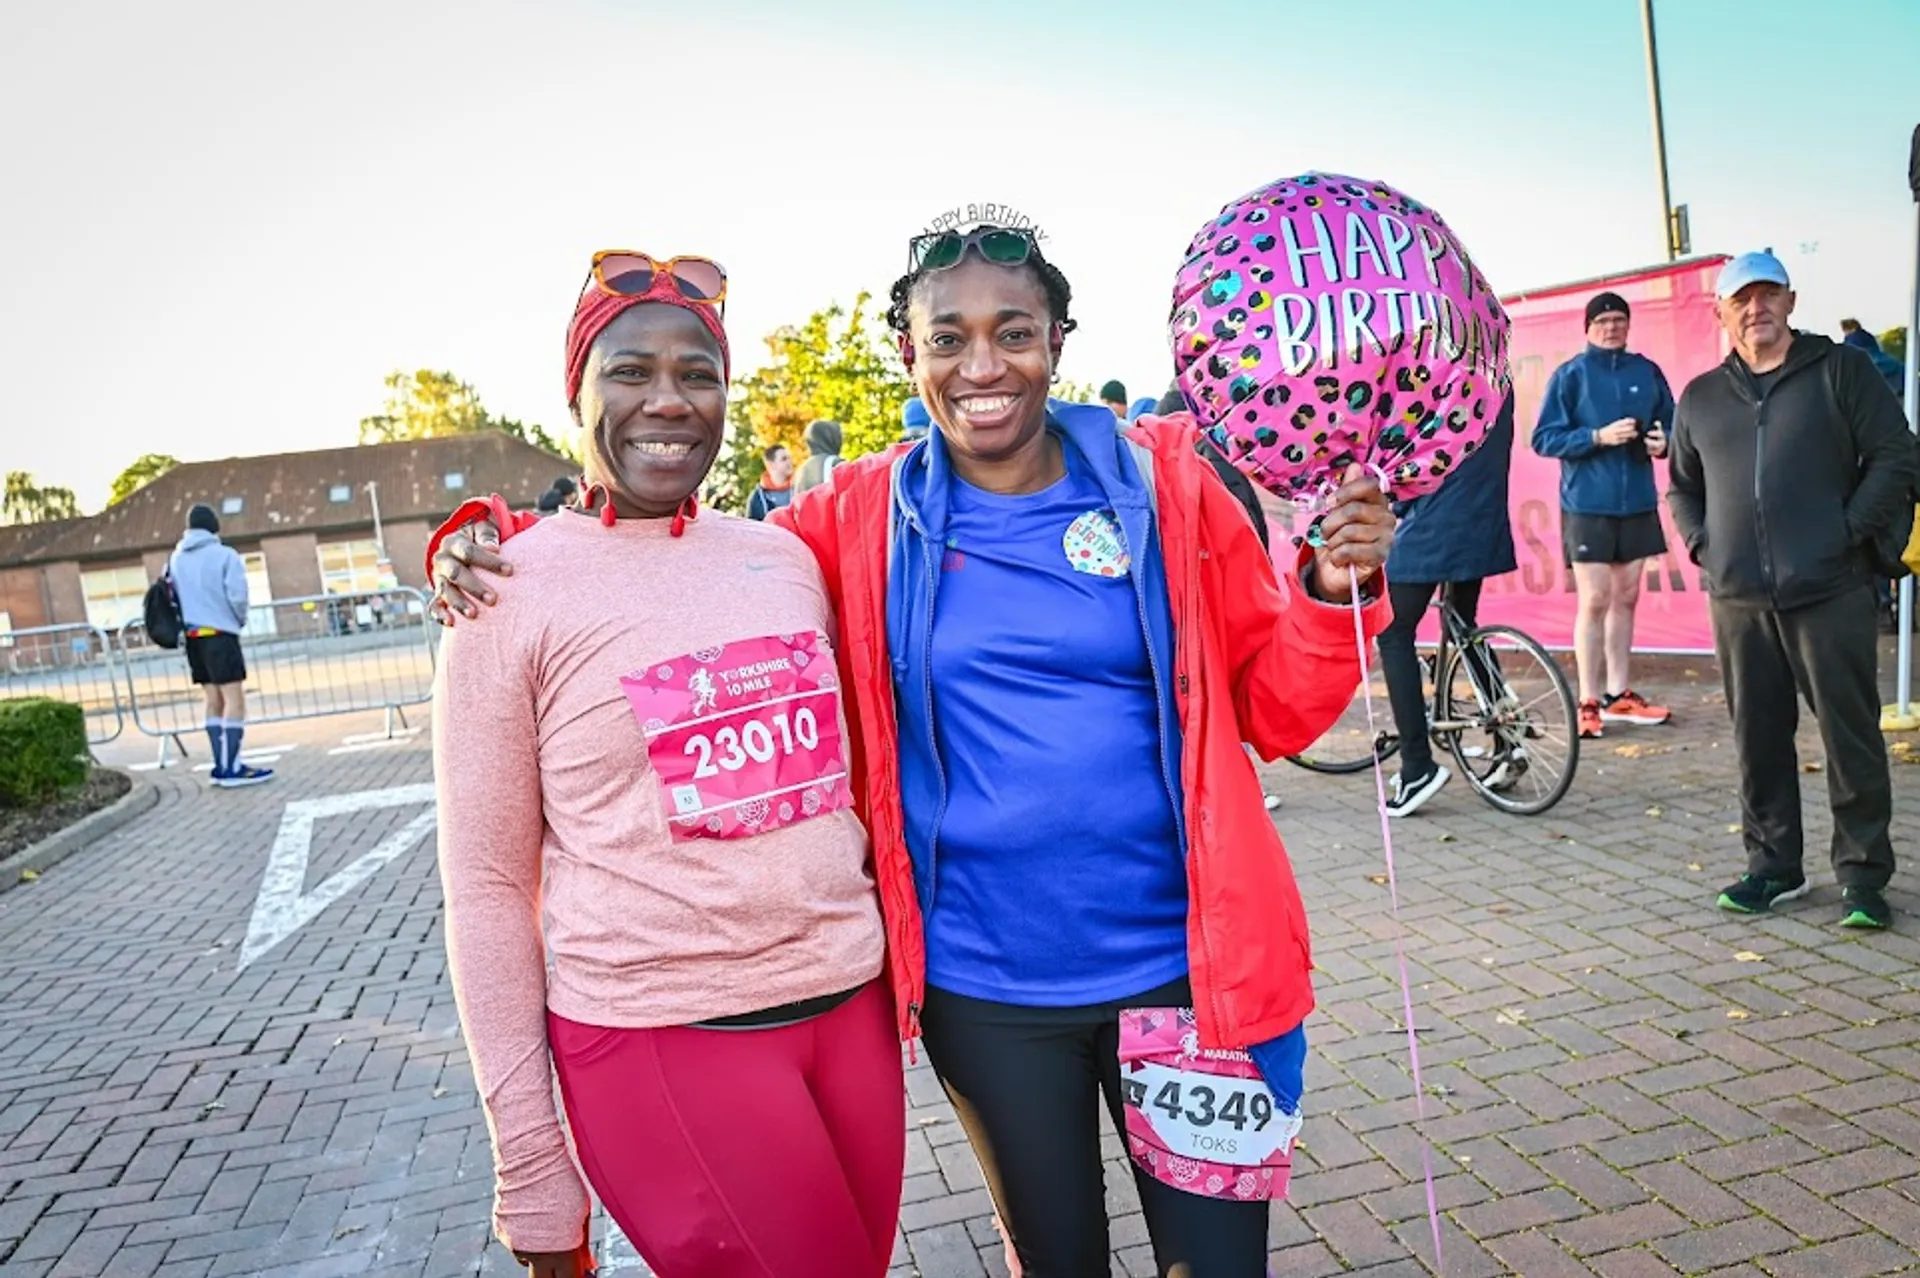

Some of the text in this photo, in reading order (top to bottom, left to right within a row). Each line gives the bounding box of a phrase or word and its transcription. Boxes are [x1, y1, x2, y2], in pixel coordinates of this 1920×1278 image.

[1280, 211, 1473, 300] HAPPY
[1274, 287, 1499, 382] BIRTHDAY
[718, 657, 791, 683] YORKSHIRE
[726, 676, 772, 697] 10 MILE
[684, 706, 819, 779] 23010
[1152, 1080, 1272, 1132] 4349
[1190, 1132, 1238, 1154] TOKS
